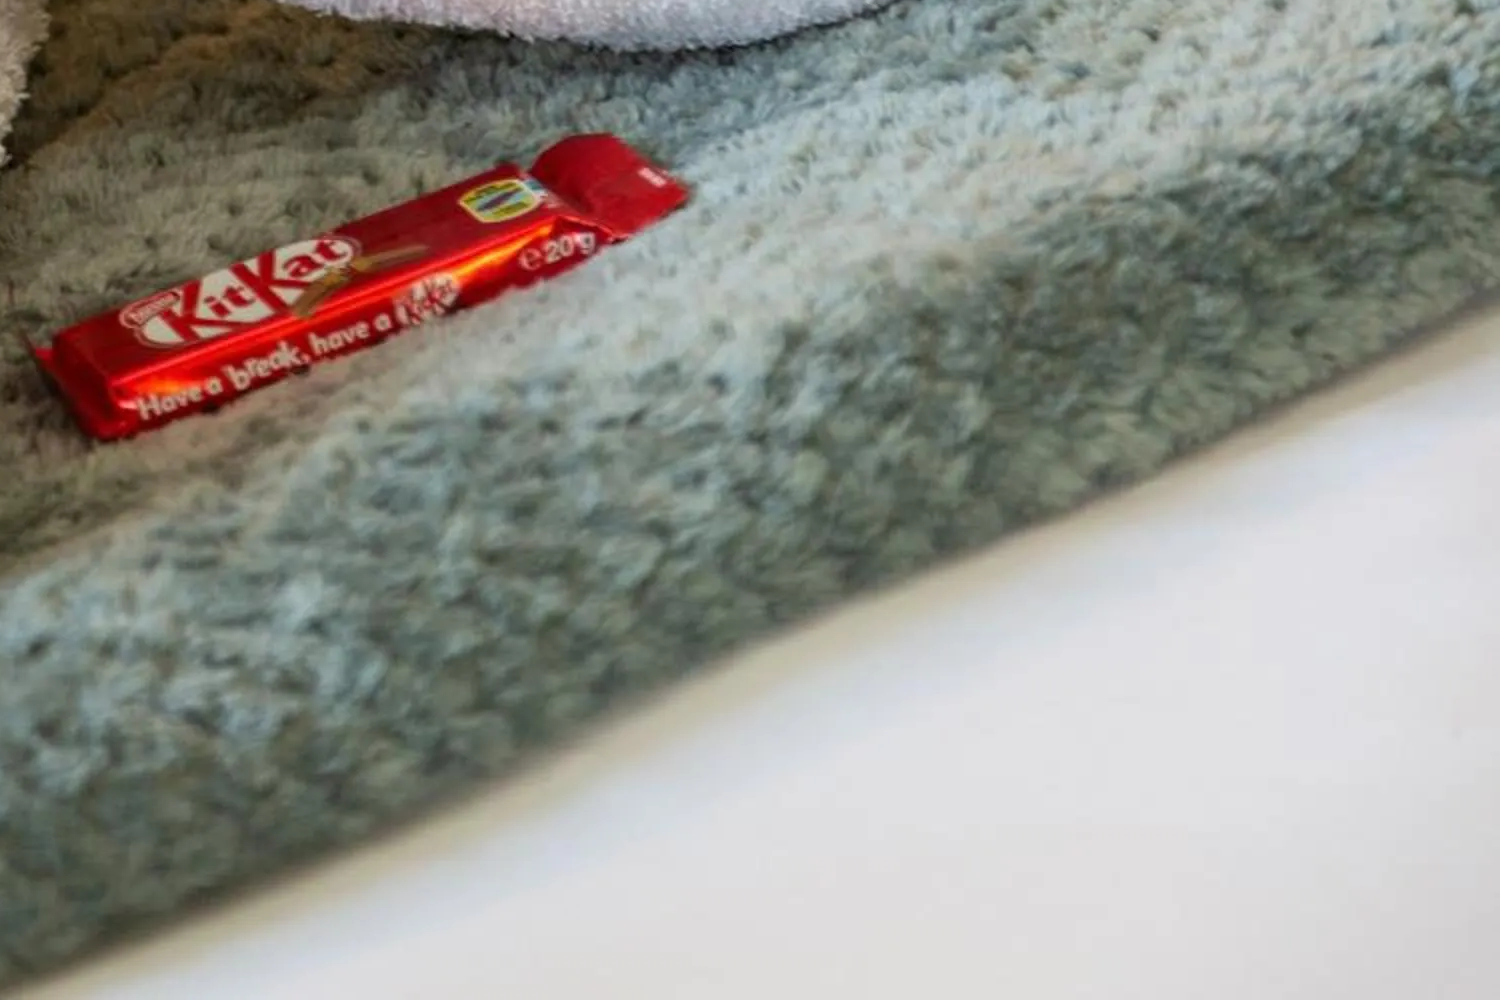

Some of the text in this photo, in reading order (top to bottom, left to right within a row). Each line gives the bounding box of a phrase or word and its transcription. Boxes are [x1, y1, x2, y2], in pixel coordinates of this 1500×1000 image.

[159, 238, 347, 342] KitKat
[136, 386, 202, 420] Have
[204, 376, 223, 396] a
[308, 321, 370, 355] have
[373, 312, 392, 332] a
